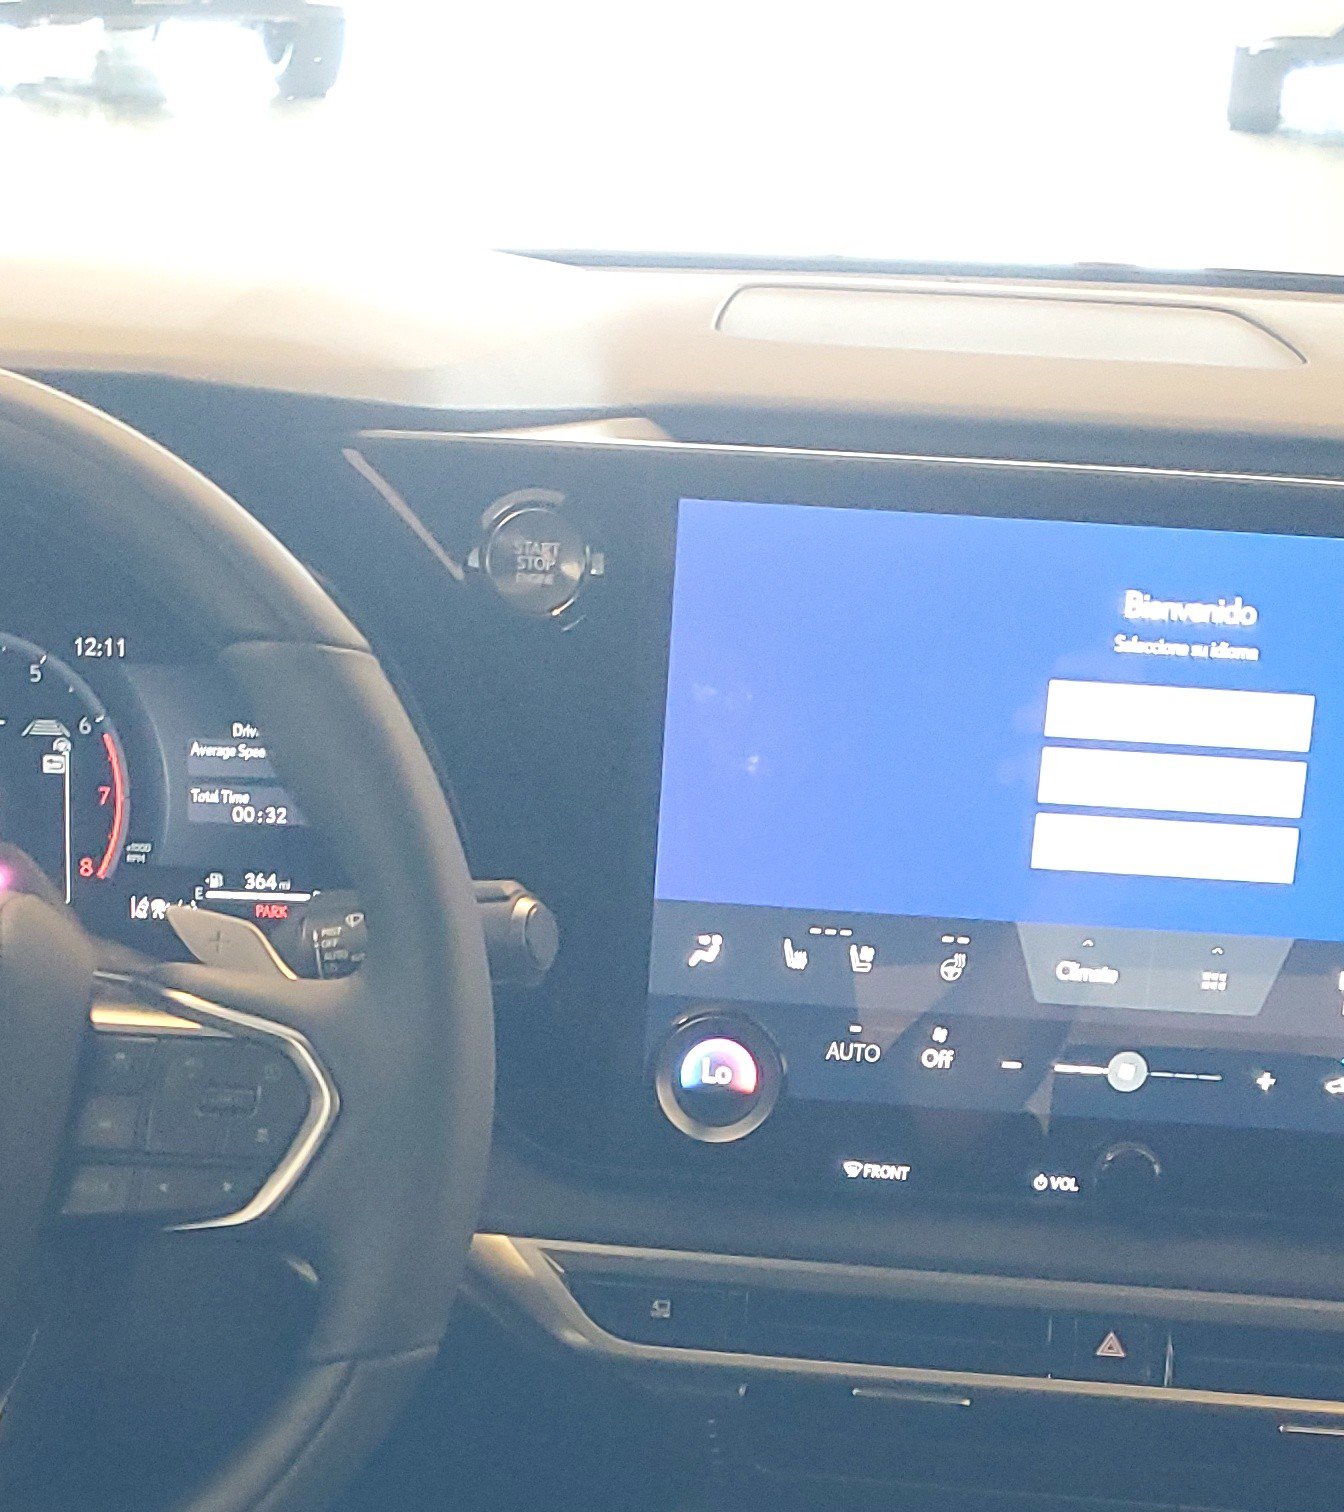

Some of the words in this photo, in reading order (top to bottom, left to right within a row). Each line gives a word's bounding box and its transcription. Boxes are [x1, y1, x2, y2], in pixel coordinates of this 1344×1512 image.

[517, 555, 556, 571] STOP
[1124, 589, 1259, 626] Bienvenido
[74, 636, 126, 658] 12:11
[29, 664, 42, 683] 5
[78, 716, 92, 735] 6
[232, 722, 260, 738] Driv
[190, 741, 236, 760] Average
[99, 786, 111, 806] 7
[190, 787, 219, 804] Total
[220, 788, 250, 805] Time
[79, 857, 94, 878] 8
[244, 872, 278, 891] 364
[194, 886, 204, 900] E
[255, 904, 288, 919] PARK
[825, 1040, 882, 1064] AUTO
[920, 1048, 955, 1071] Off
[701, 1056, 733, 1086] Lo
[862, 1162, 911, 1182] FRONT
[1050, 1175, 1081, 1193] VOL
